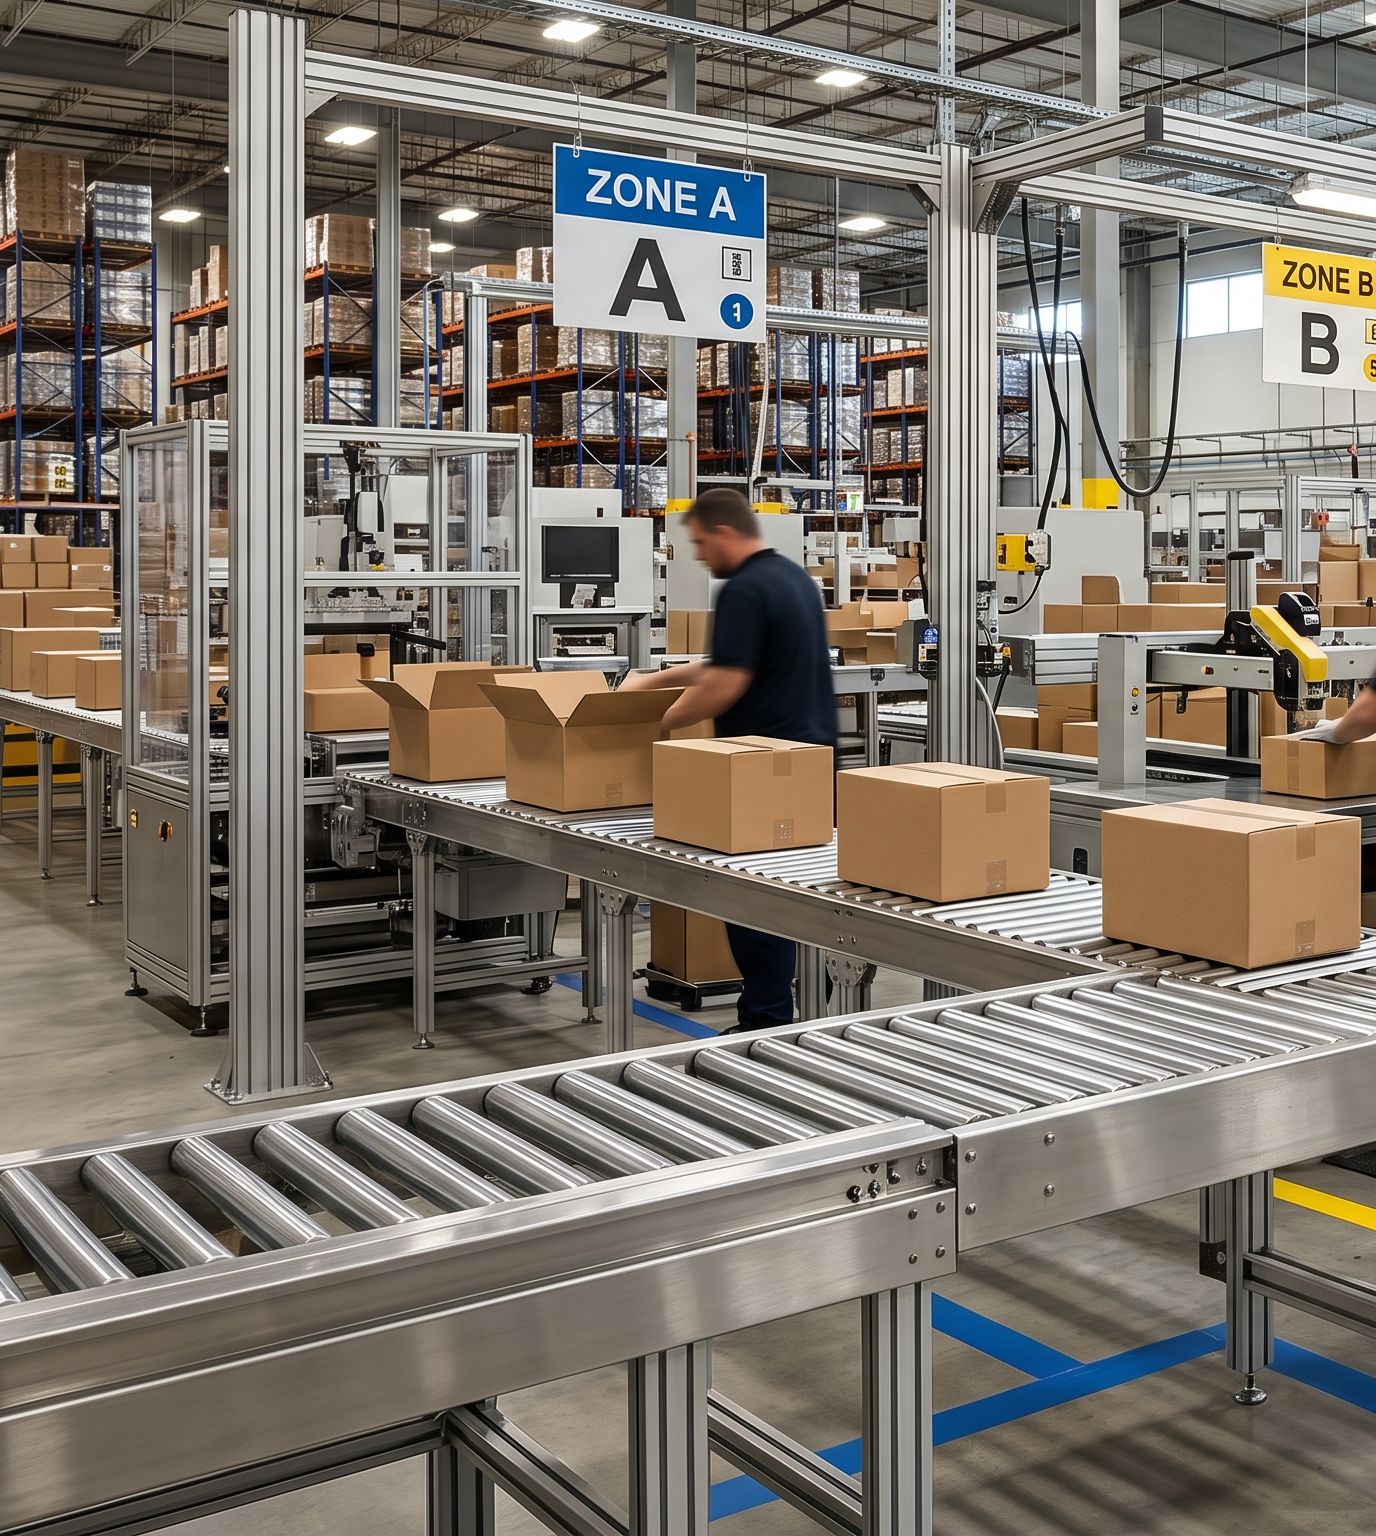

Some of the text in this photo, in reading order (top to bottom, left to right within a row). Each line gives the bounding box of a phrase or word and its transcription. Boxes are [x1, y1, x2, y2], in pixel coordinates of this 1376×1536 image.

[586, 168, 737, 221] ZONE A
[608, 237, 686, 322] A
[1282, 260, 1374, 297] ZONE B
[1301, 311, 1340, 375] B
